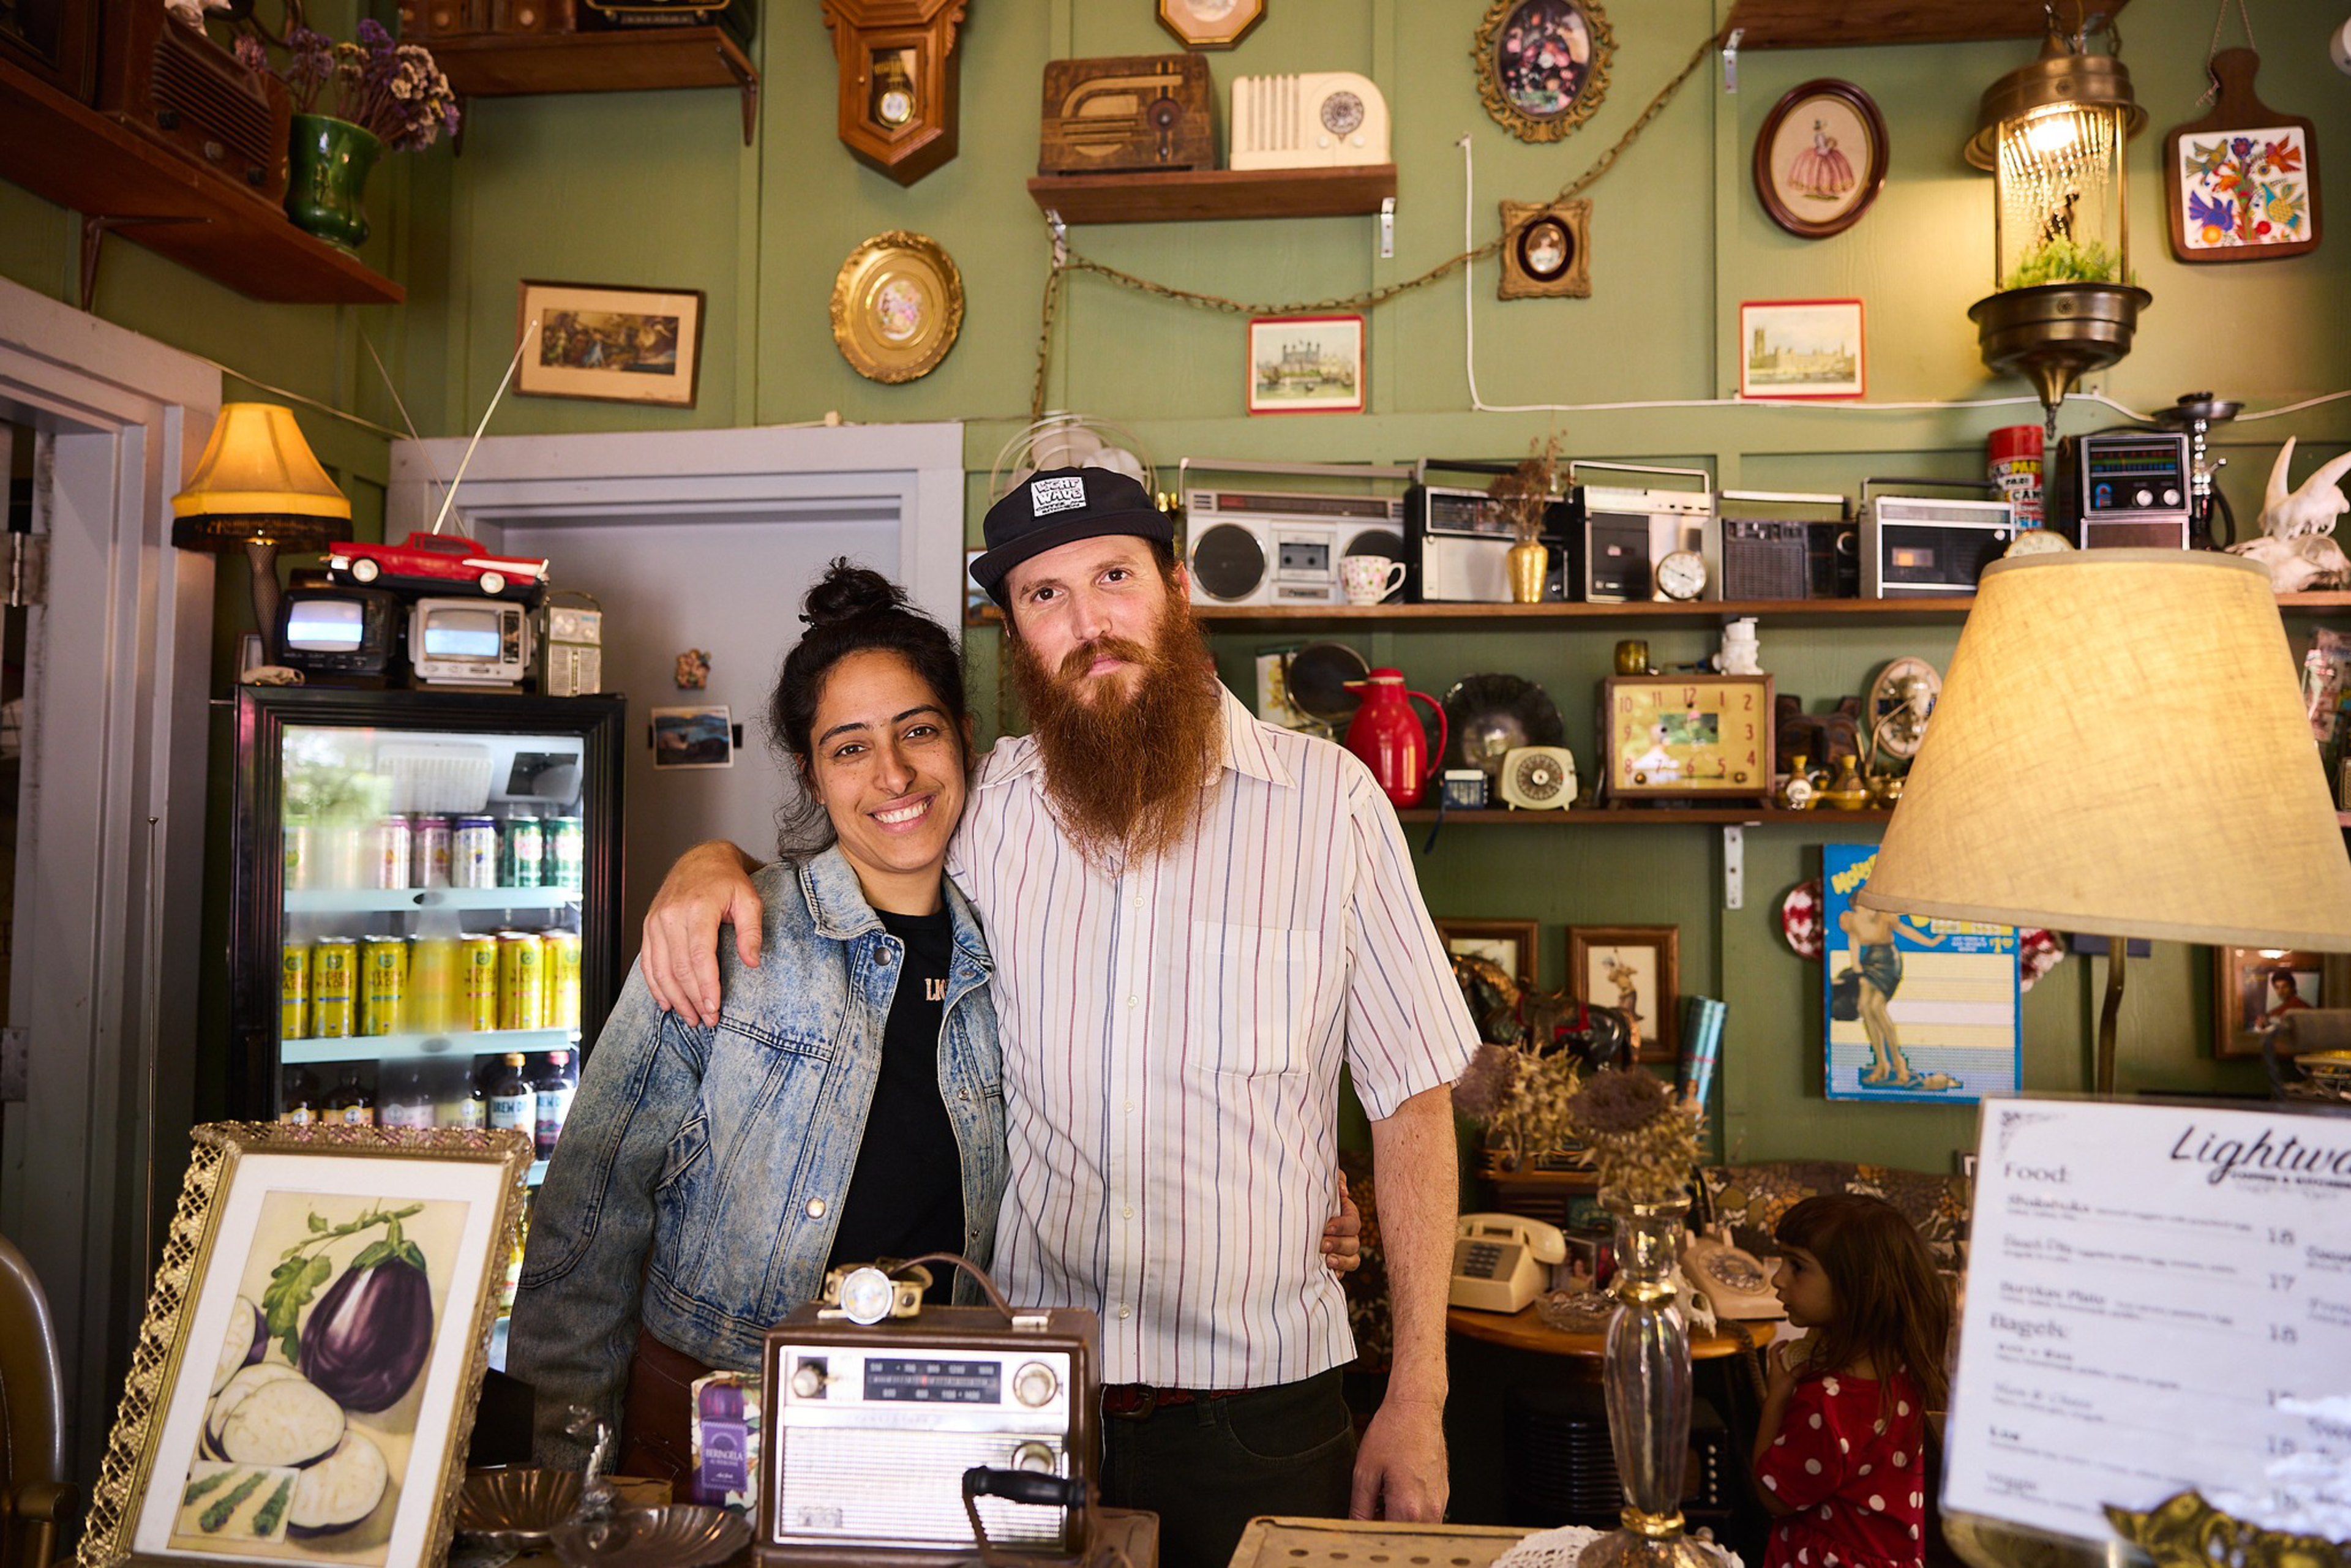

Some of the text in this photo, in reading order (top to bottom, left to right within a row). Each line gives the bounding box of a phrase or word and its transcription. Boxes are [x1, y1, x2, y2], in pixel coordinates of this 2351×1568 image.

[1035, 478, 1080, 493] LIGHT
[1037, 488, 1082, 505] WAVE
[1620, 697, 1633, 713] 10
[1652, 691, 1662, 708] 11
[1684, 688, 1697, 705] 12
[1720, 691, 1725, 707] 1
[1743, 694, 1753, 711] 2
[1624, 725, 1632, 741] 9
[1745, 724, 1754, 741] 3
[1624, 758, 1633, 775] 8
[1687, 758, 1695, 775] 6
[1717, 758, 1726, 775] 5
[1746, 750, 1756, 766] 4
